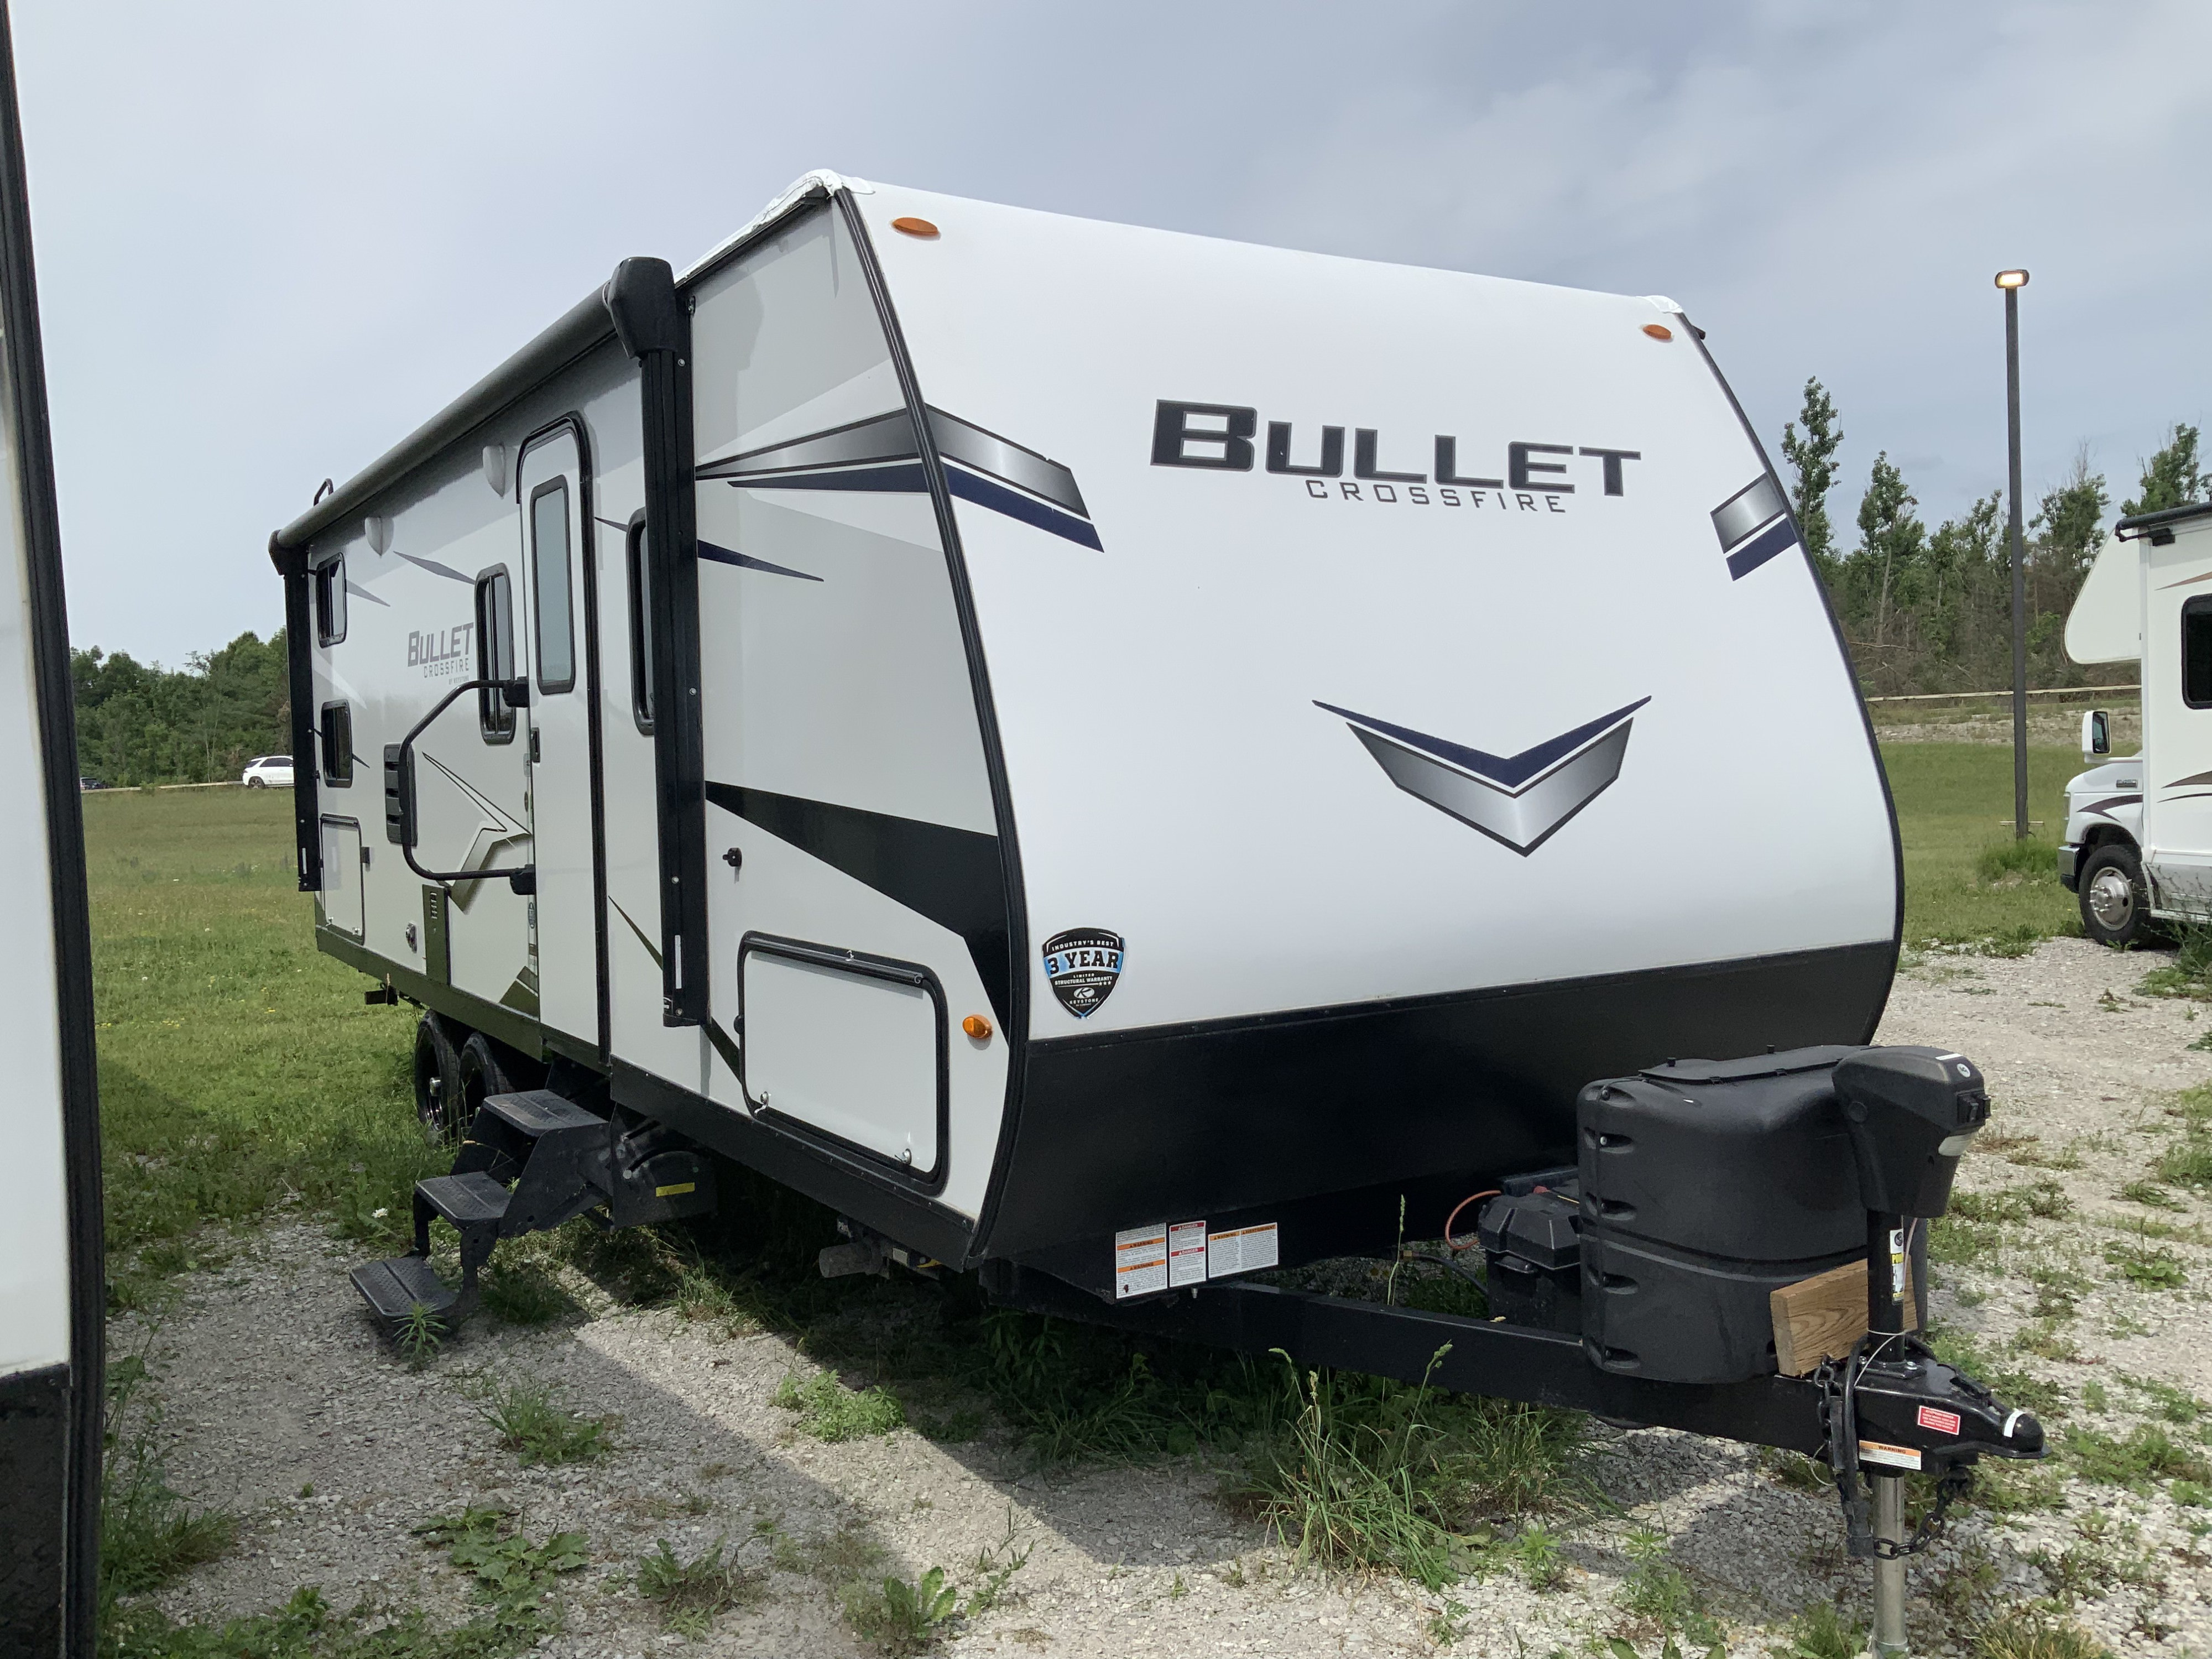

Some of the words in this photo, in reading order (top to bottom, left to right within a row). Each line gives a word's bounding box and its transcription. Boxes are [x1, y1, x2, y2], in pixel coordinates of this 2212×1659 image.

[1150, 399, 1641, 497] BULLET
[1305, 479, 1566, 513] CROSSFIRE
[408, 622, 474, 667] BULLET
[424, 658, 469, 678] CROSSFIRE
[1052, 940, 1094, 951] INDUSTRY'S
[1047, 957, 1060, 974] 3
[1065, 950, 1119, 969] YEAR
[1878, 1445, 1906, 1454] WARNING
